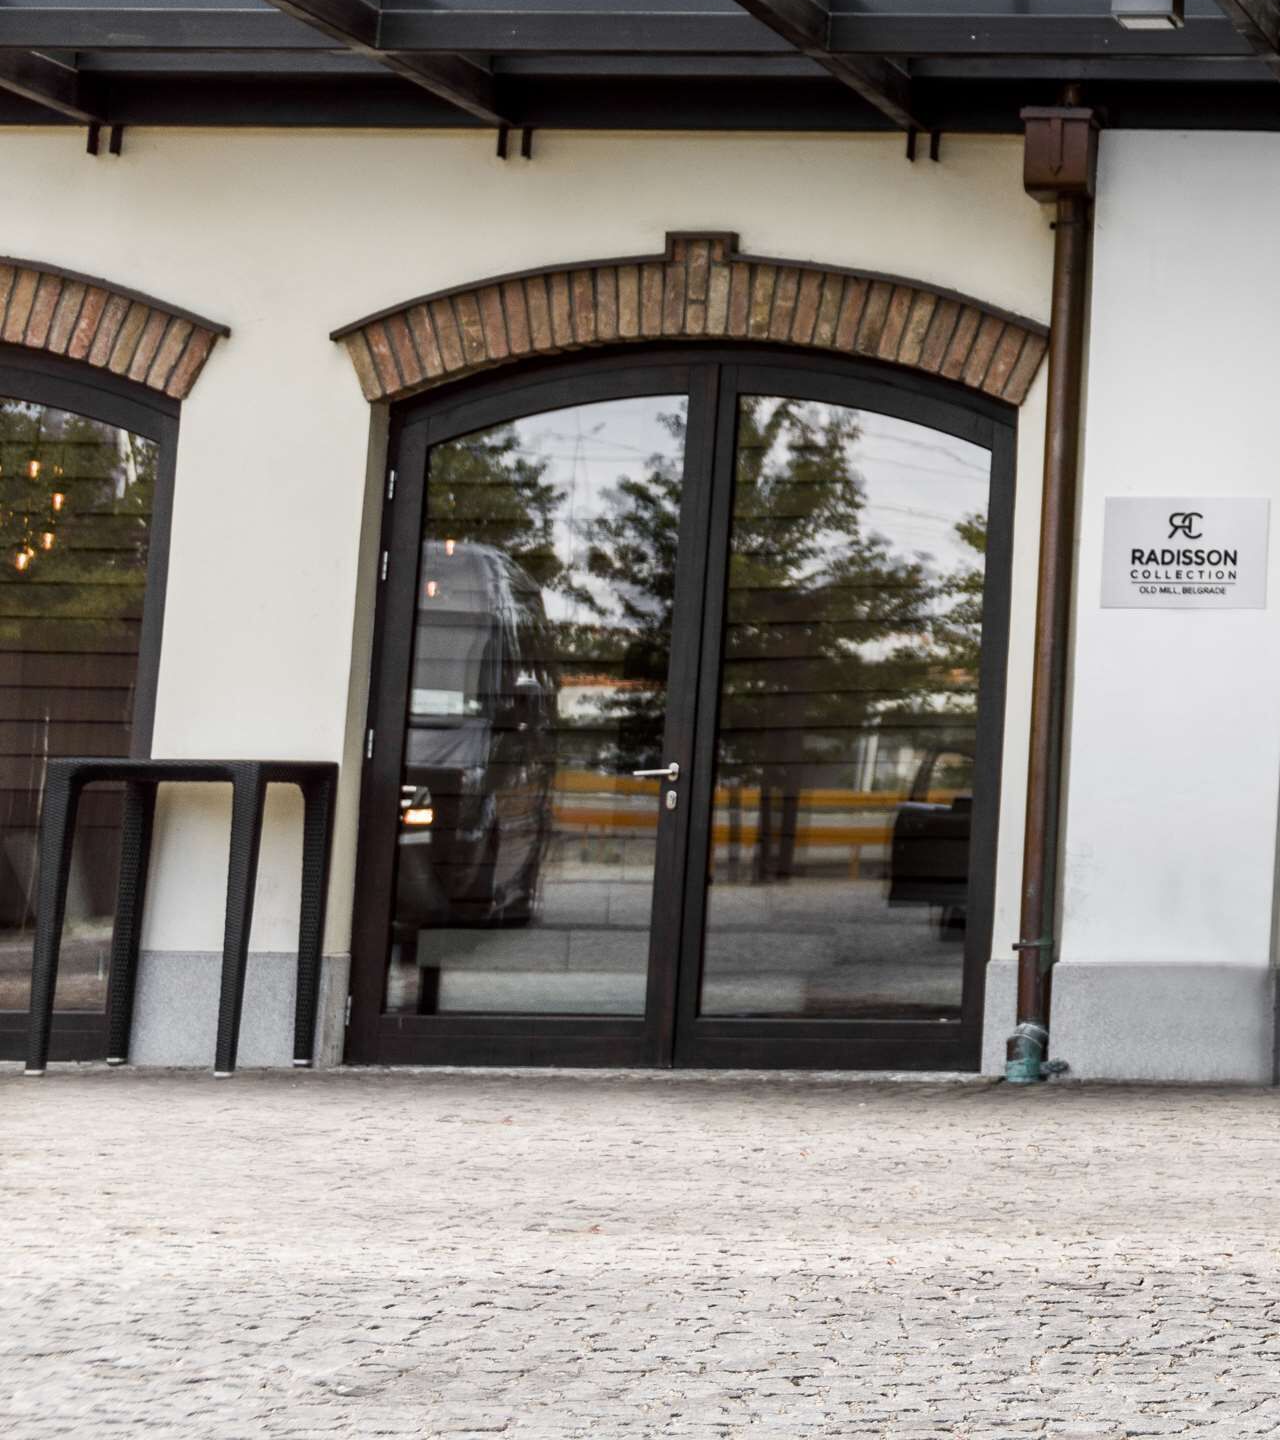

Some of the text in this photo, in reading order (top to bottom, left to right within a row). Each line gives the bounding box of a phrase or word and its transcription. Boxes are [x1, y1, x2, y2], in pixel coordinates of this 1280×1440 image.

[1131, 548, 1238, 566] RADISSON
[1130, 569, 1237, 580] COLLECTION
[1139, 586, 1157, 594] OLD
[1182, 586, 1227, 595] BELGRADE
